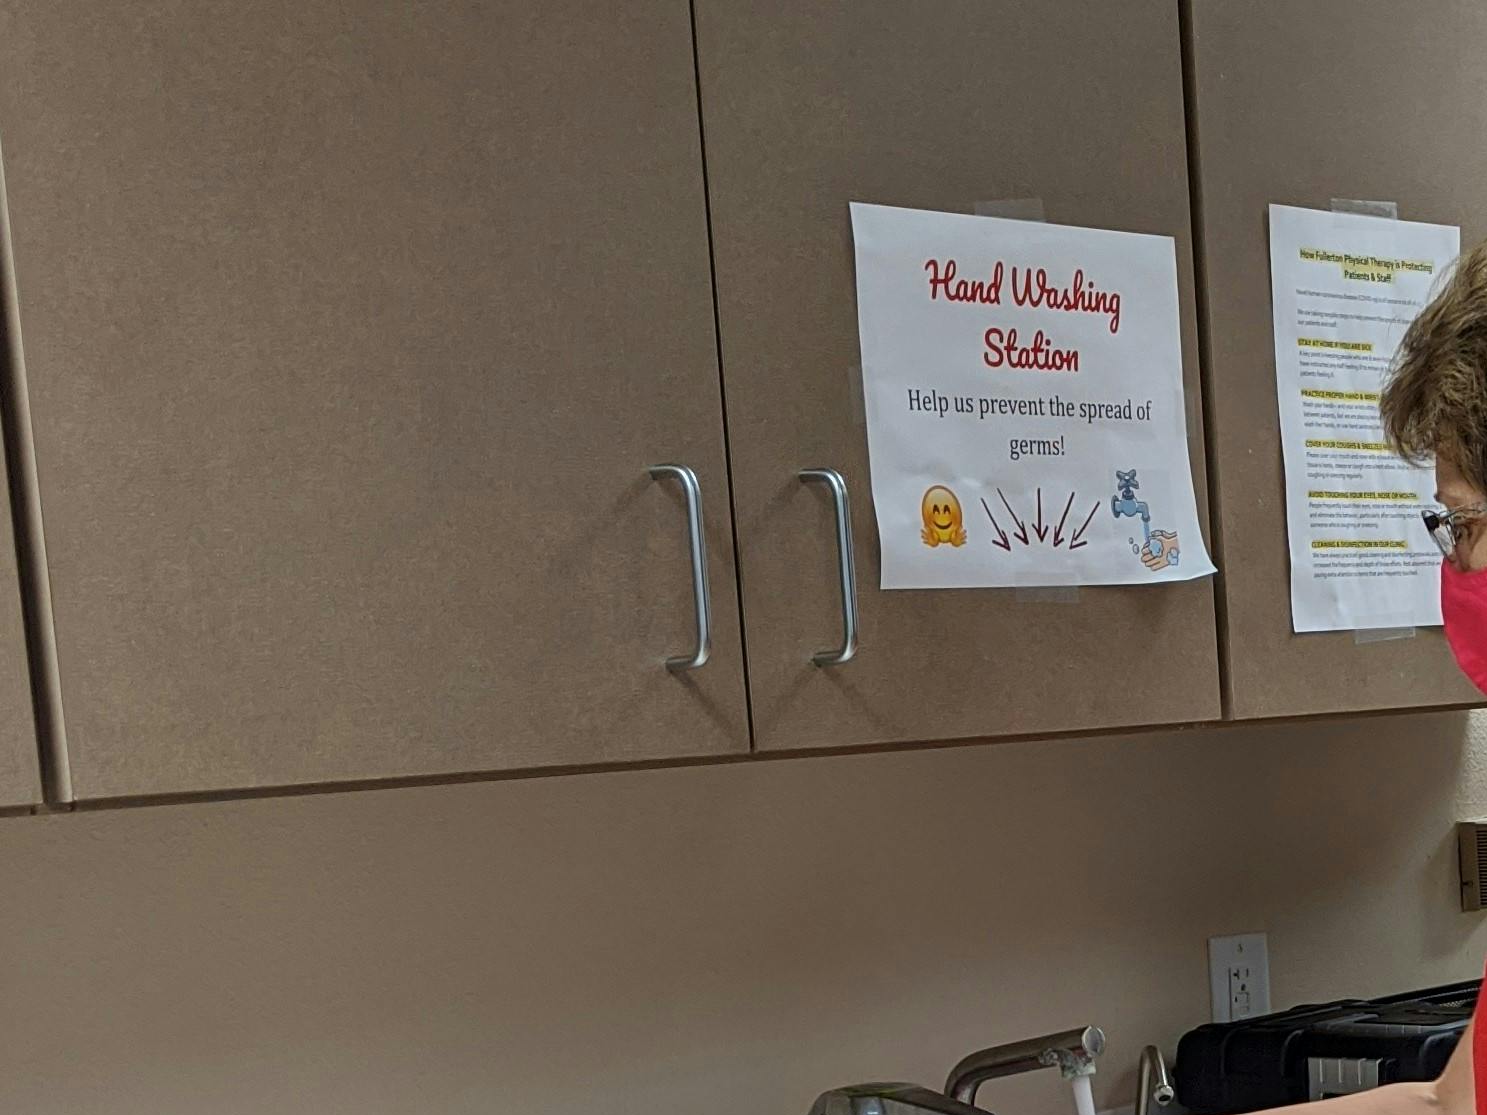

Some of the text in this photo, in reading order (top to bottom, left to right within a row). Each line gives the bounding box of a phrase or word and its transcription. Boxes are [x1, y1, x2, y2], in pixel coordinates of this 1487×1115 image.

[1344, 254, 1369, 266] Physical
[1370, 257, 1394, 271] Therapy
[1402, 261, 1432, 274] Protecting
[1344, 270, 1370, 280] Patients
[1377, 273, 1392, 283] Staff
[925, 259, 1121, 334] Hand Washing
[983, 327, 1079, 372] Station
[907, 389, 1153, 423] Help us prevent the spread of
[1009, 435, 1065, 460] germs!
